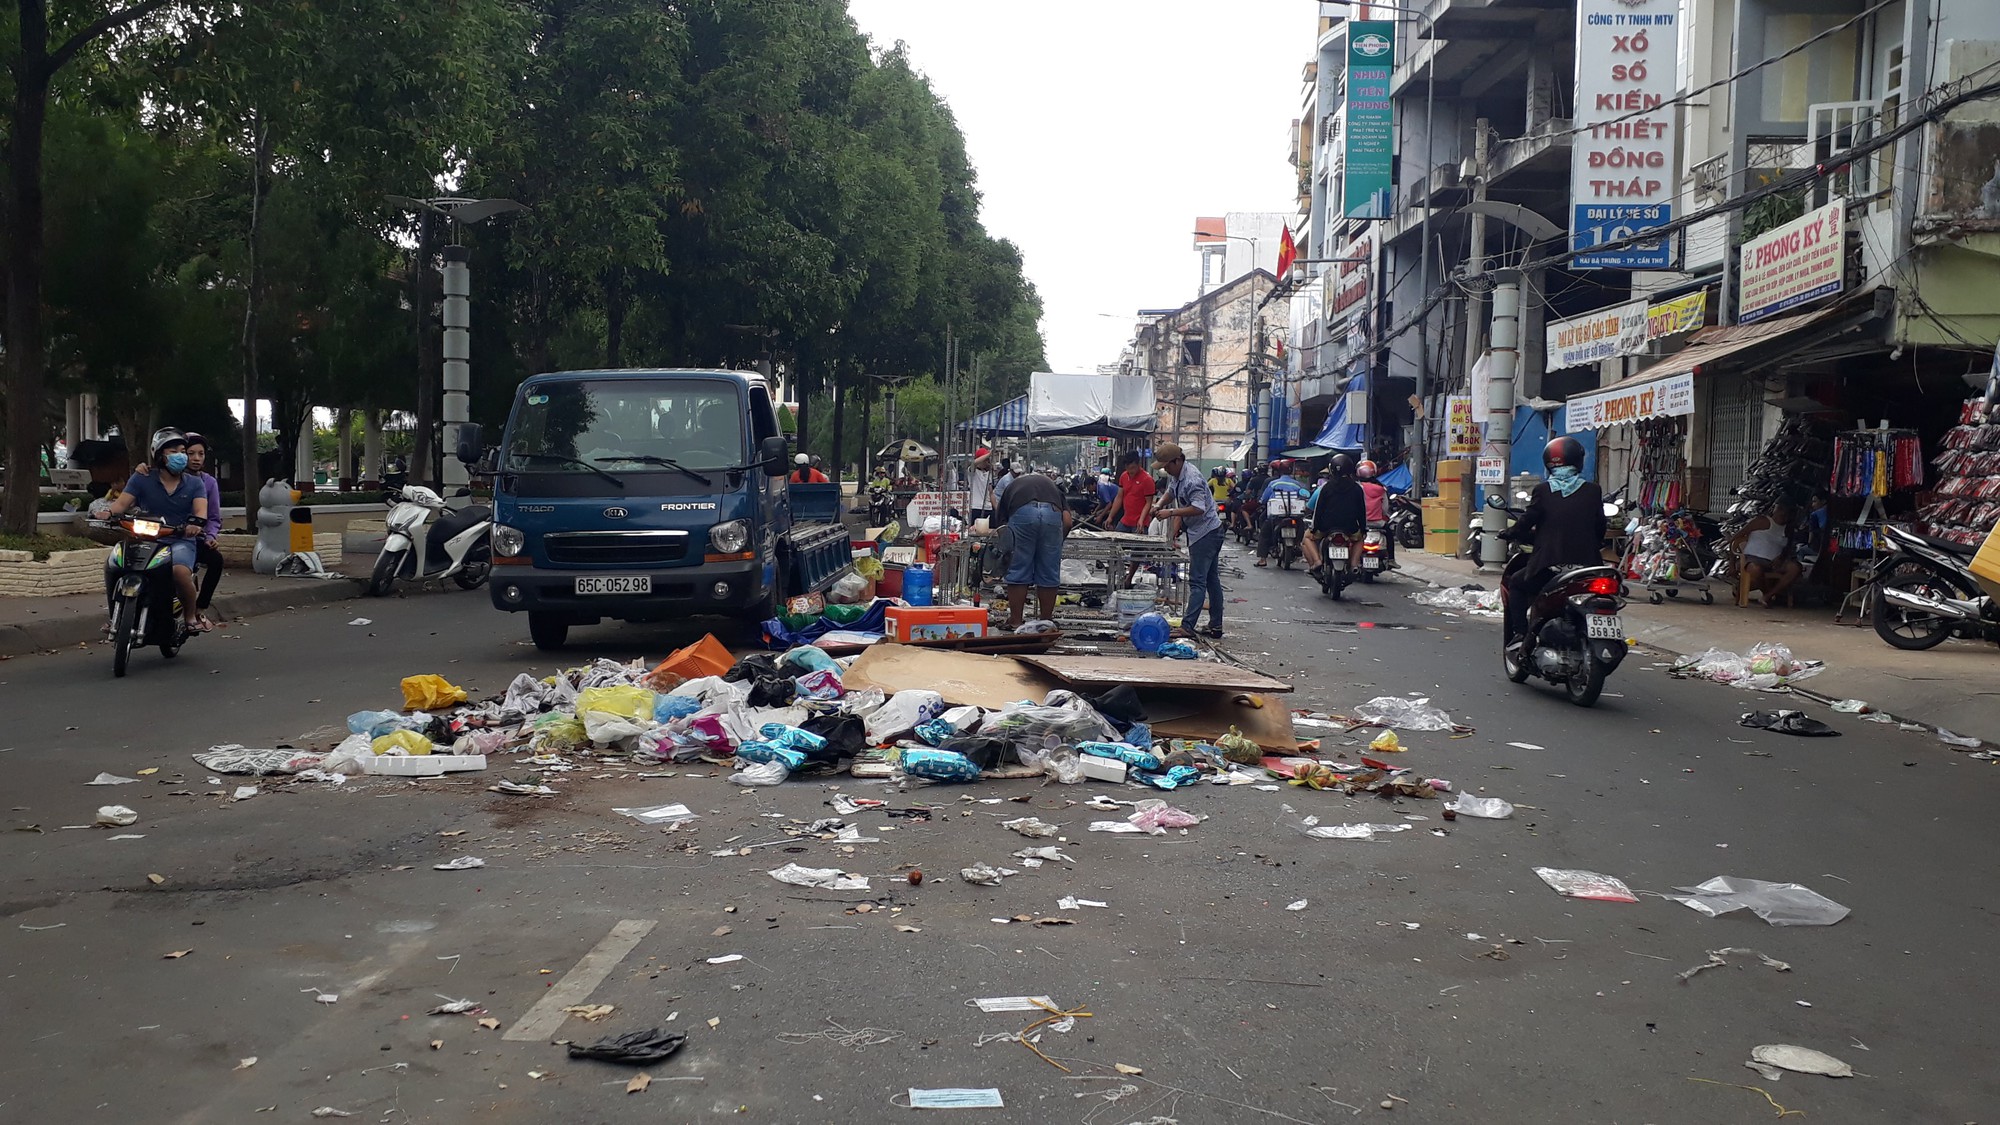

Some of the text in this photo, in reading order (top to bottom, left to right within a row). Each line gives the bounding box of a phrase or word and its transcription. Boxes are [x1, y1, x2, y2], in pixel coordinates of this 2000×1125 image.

[1588, 12, 1674, 26] CÔNG TY TNHH MTV
[1611, 28, 1649, 52] XỔ
[1612, 59, 1647, 81] SỐ
[1350, 101, 1390, 110] PHONG
[1595, 88, 1661, 111] KIẾN
[1587, 117, 1668, 140] THIẾT
[1588, 146, 1664, 168] ĐỒNG
[1589, 176, 1661, 197] THÁP
[1587, 208, 1607, 221] ĐẠI
[1609, 206, 1623, 219] LÝ
[1644, 206, 1660, 219] SỐ
[1756, 211, 1824, 269] PHONG KÝ
[1672, 310, 1678, 330] 2
[1605, 395, 1637, 422] PHONG
[1465, 425, 1480, 434] 70K
[1464, 436, 1480, 444] 80K
[518, 505, 555, 513] THACO
[607, 508, 625, 517] KIA
[661, 503, 716, 511] FRONTIER
[577, 578, 649, 593] 65C-052.98
[1593, 616, 1617, 627] 65-B1
[1590, 627, 1621, 638] 368.38
